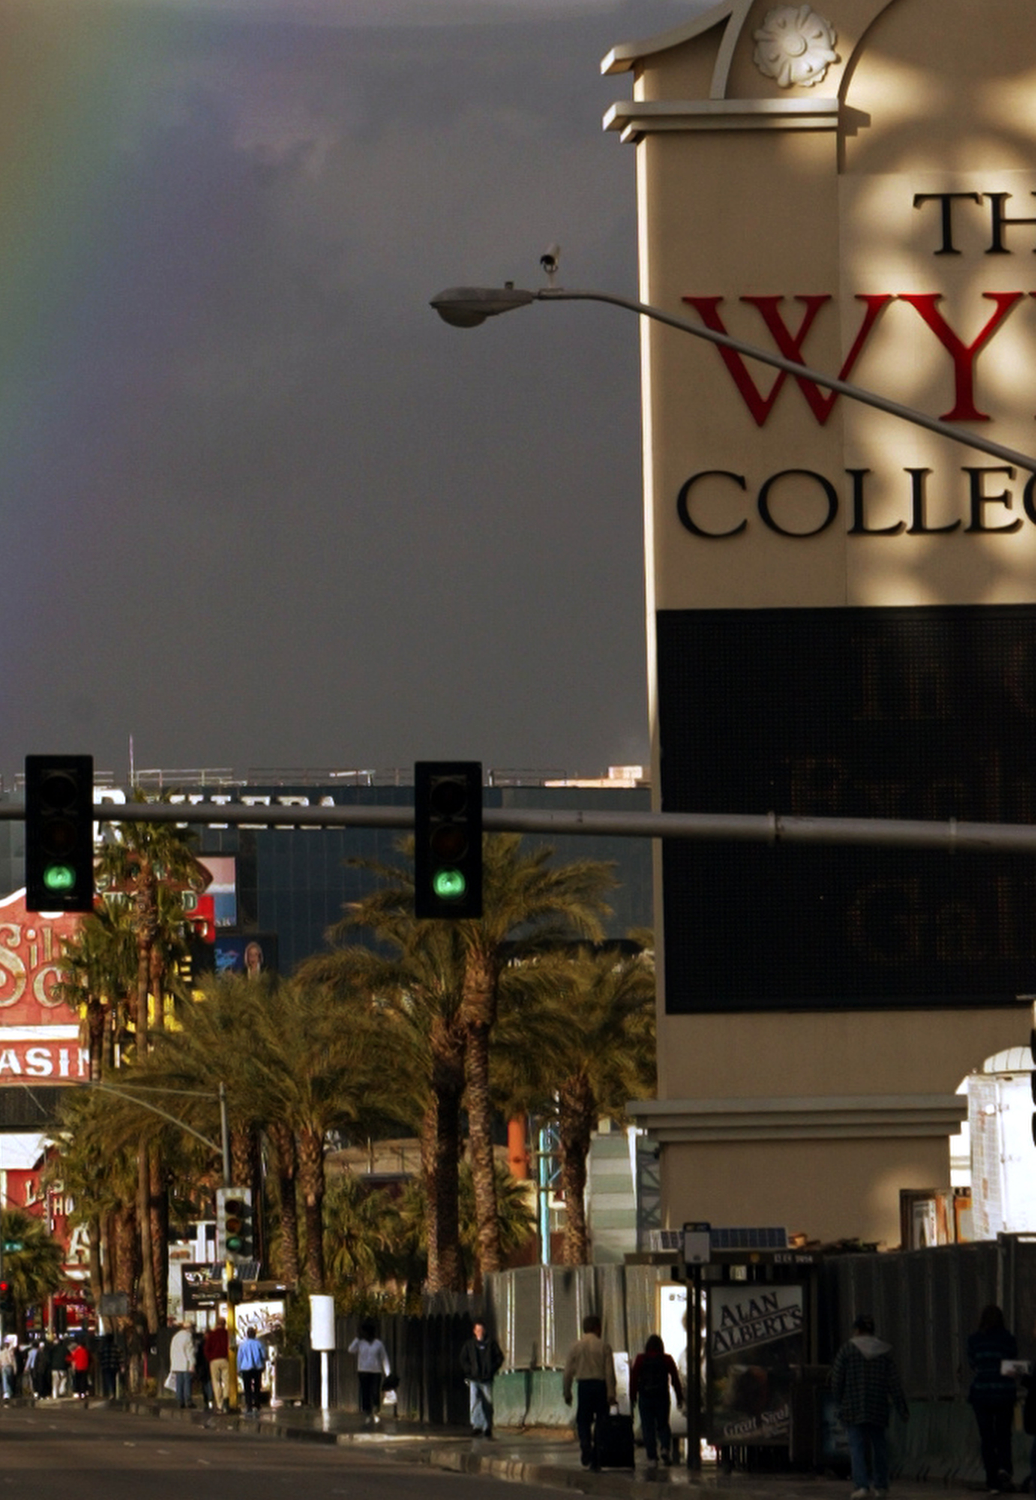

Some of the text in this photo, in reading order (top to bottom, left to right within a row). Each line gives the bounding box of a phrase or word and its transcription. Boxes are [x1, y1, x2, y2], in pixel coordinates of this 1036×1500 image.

[681, 291, 1036, 427] WY
[676, 466, 1036, 539] COLLE
[711, 1308, 804, 1354] ALBERT'S
[721, 1292, 780, 1327] ALAN
